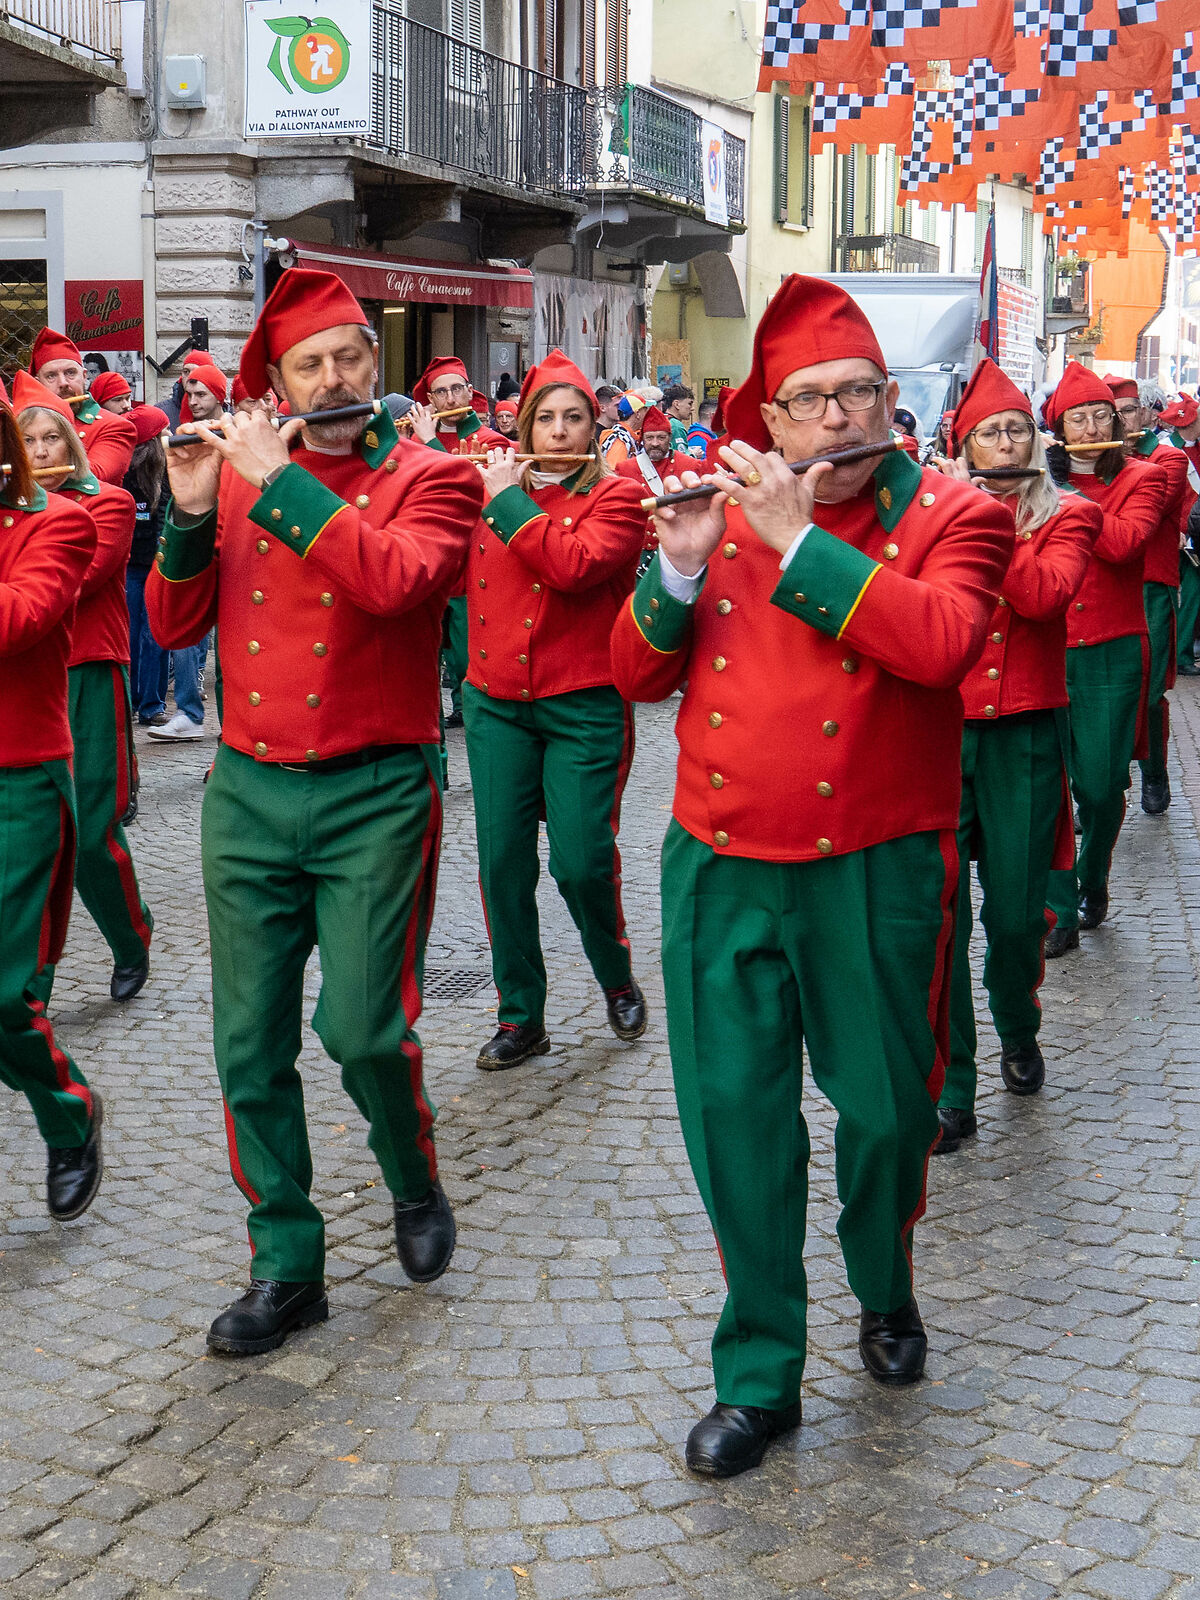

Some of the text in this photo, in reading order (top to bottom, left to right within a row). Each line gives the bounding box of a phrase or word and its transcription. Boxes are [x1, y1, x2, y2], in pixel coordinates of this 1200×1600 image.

[275, 108, 340, 118] PATHWAY OUT
[249, 120, 367, 132] VIA DI ALLONTANAMENTO
